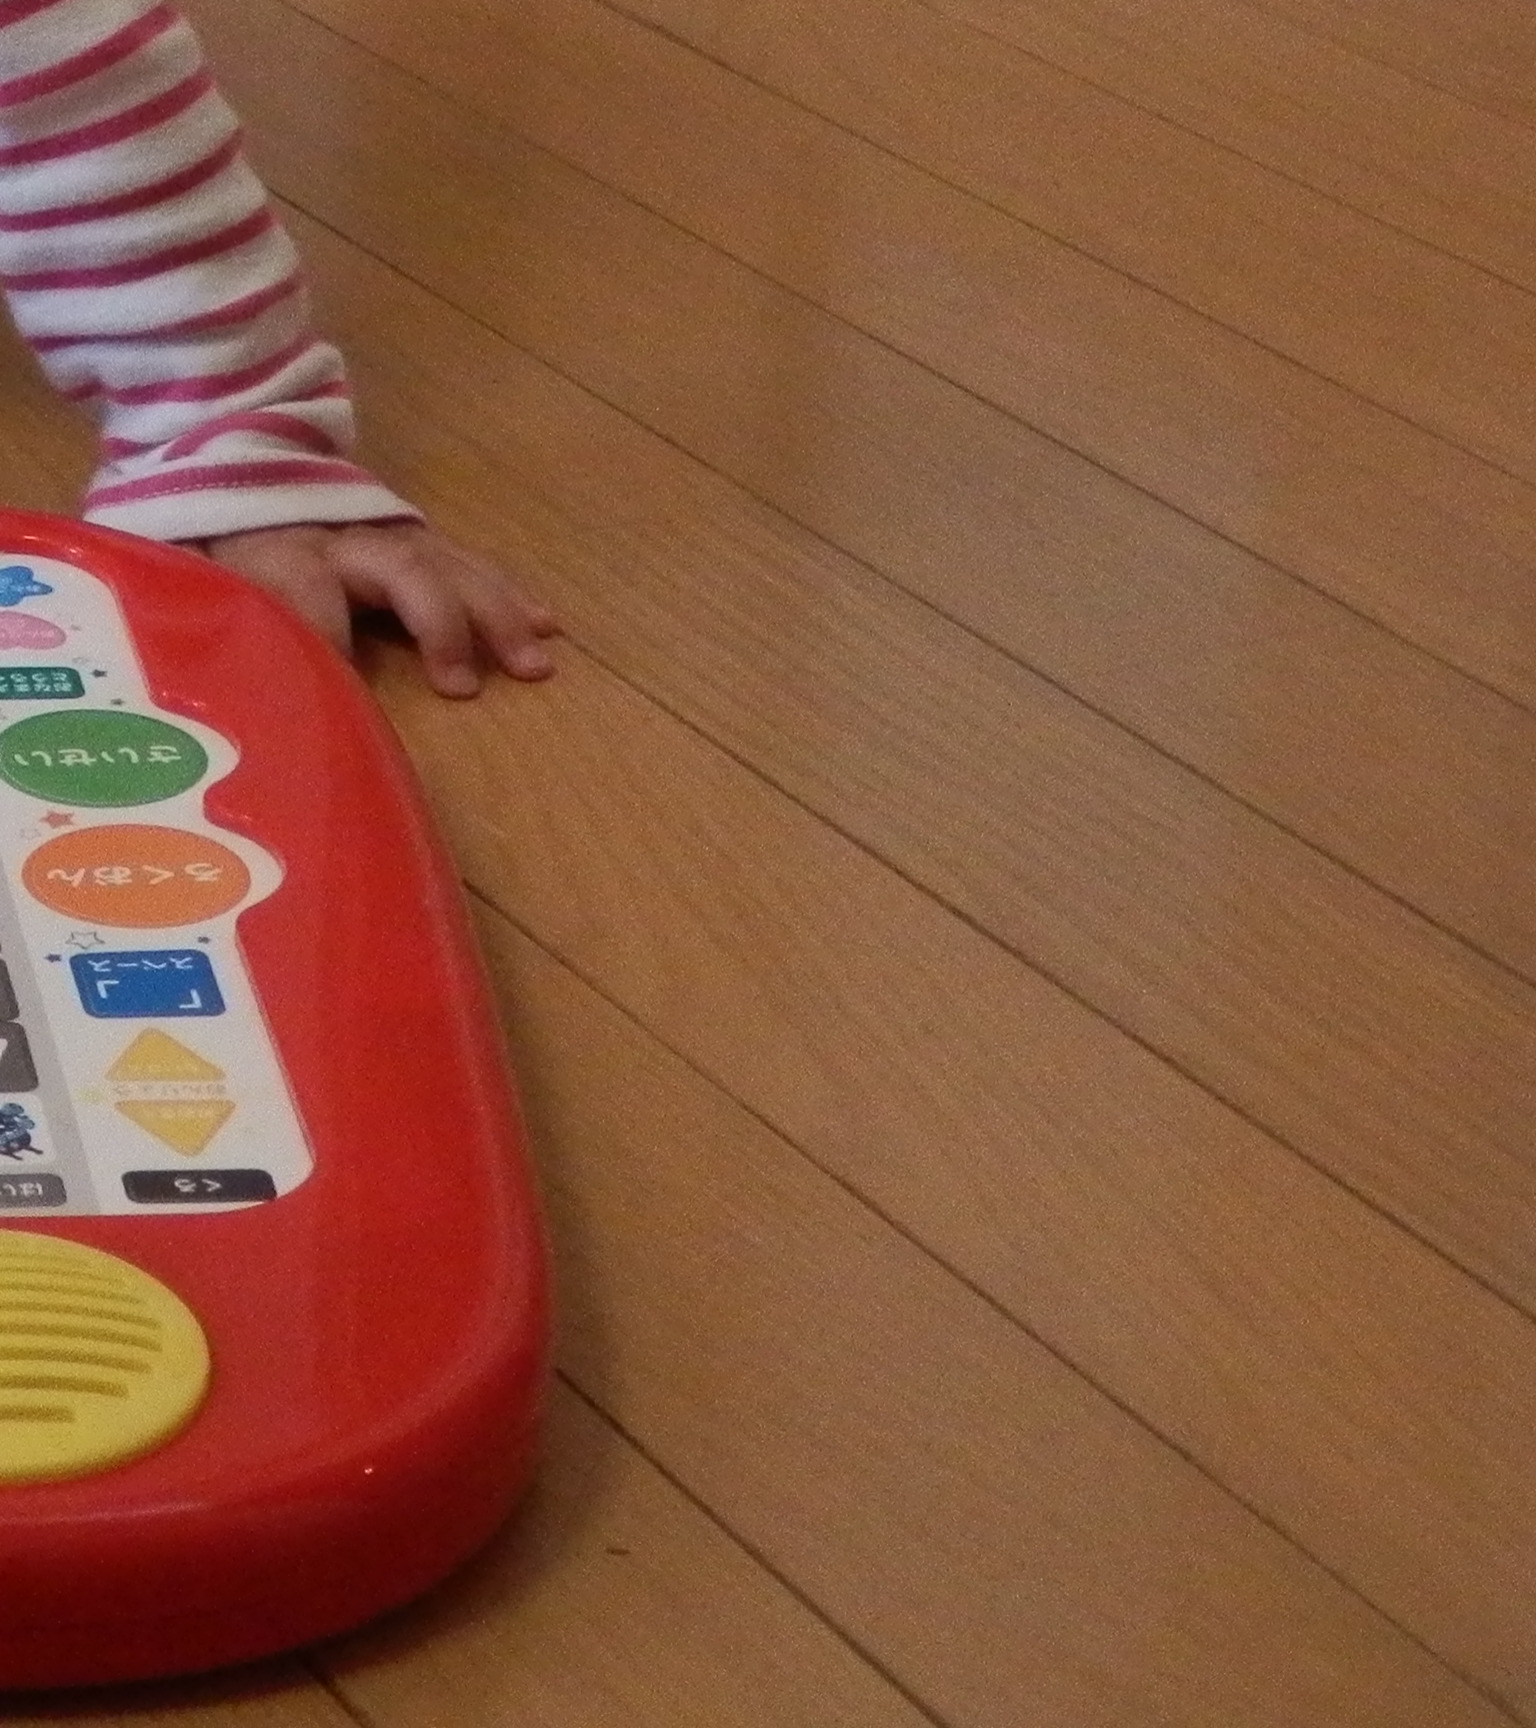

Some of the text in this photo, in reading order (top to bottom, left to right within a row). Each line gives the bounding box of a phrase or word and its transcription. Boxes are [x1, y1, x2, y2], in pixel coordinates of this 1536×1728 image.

[12, 743, 180, 766] さいせい
[47, 861, 219, 886] ろくおん
[86, 956, 192, 970] スペース
[173, 1178, 220, 1192] くろ
